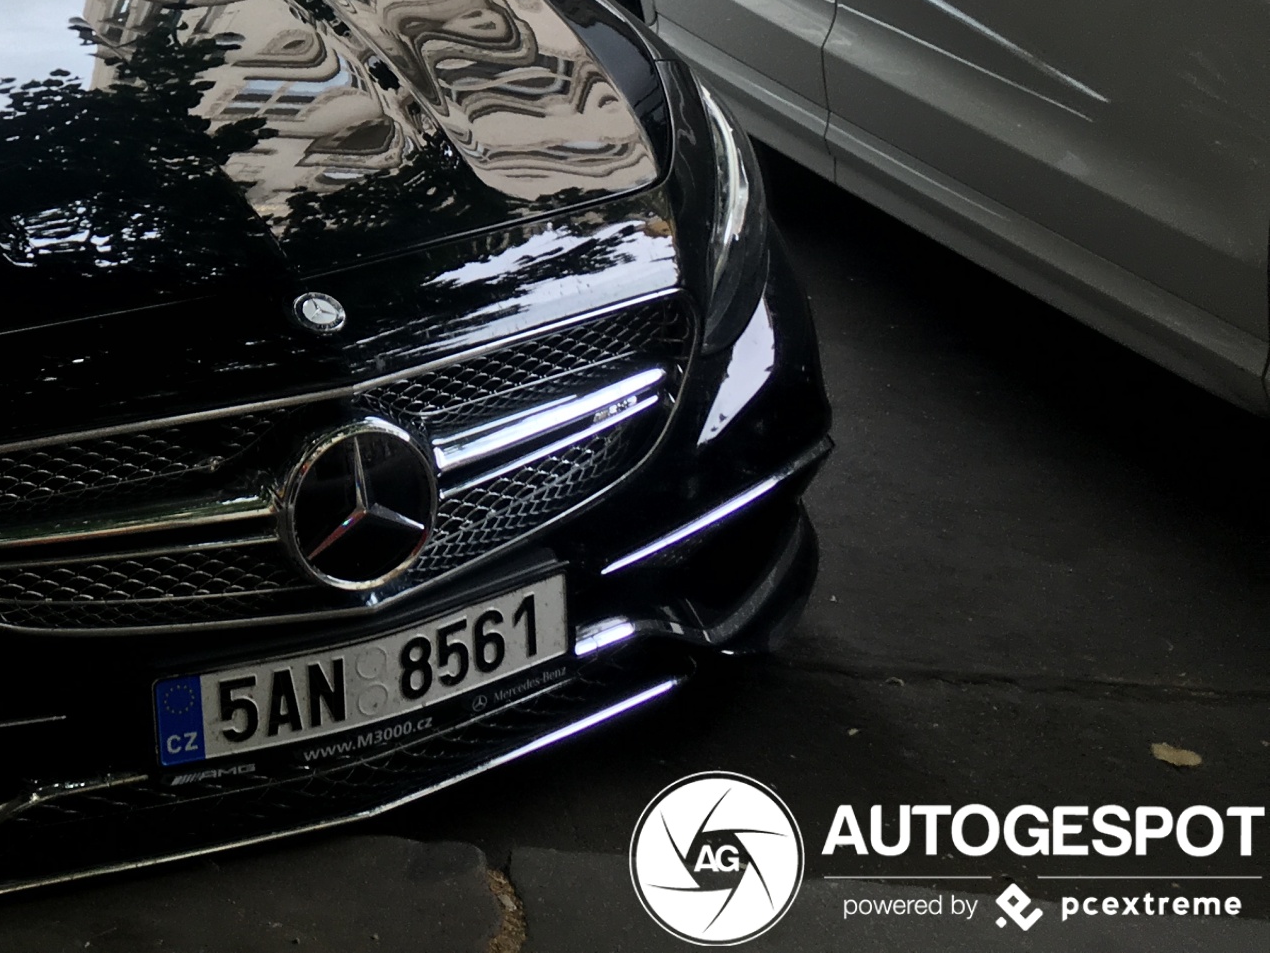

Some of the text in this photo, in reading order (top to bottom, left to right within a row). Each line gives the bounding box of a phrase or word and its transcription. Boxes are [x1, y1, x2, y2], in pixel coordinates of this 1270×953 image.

[220, 592, 537, 743] 5AN 8561
[493, 666, 566, 702] Mercedes-Benz
[167, 732, 198, 754] CZ
[303, 716, 433, 761] www.M3000.cz
